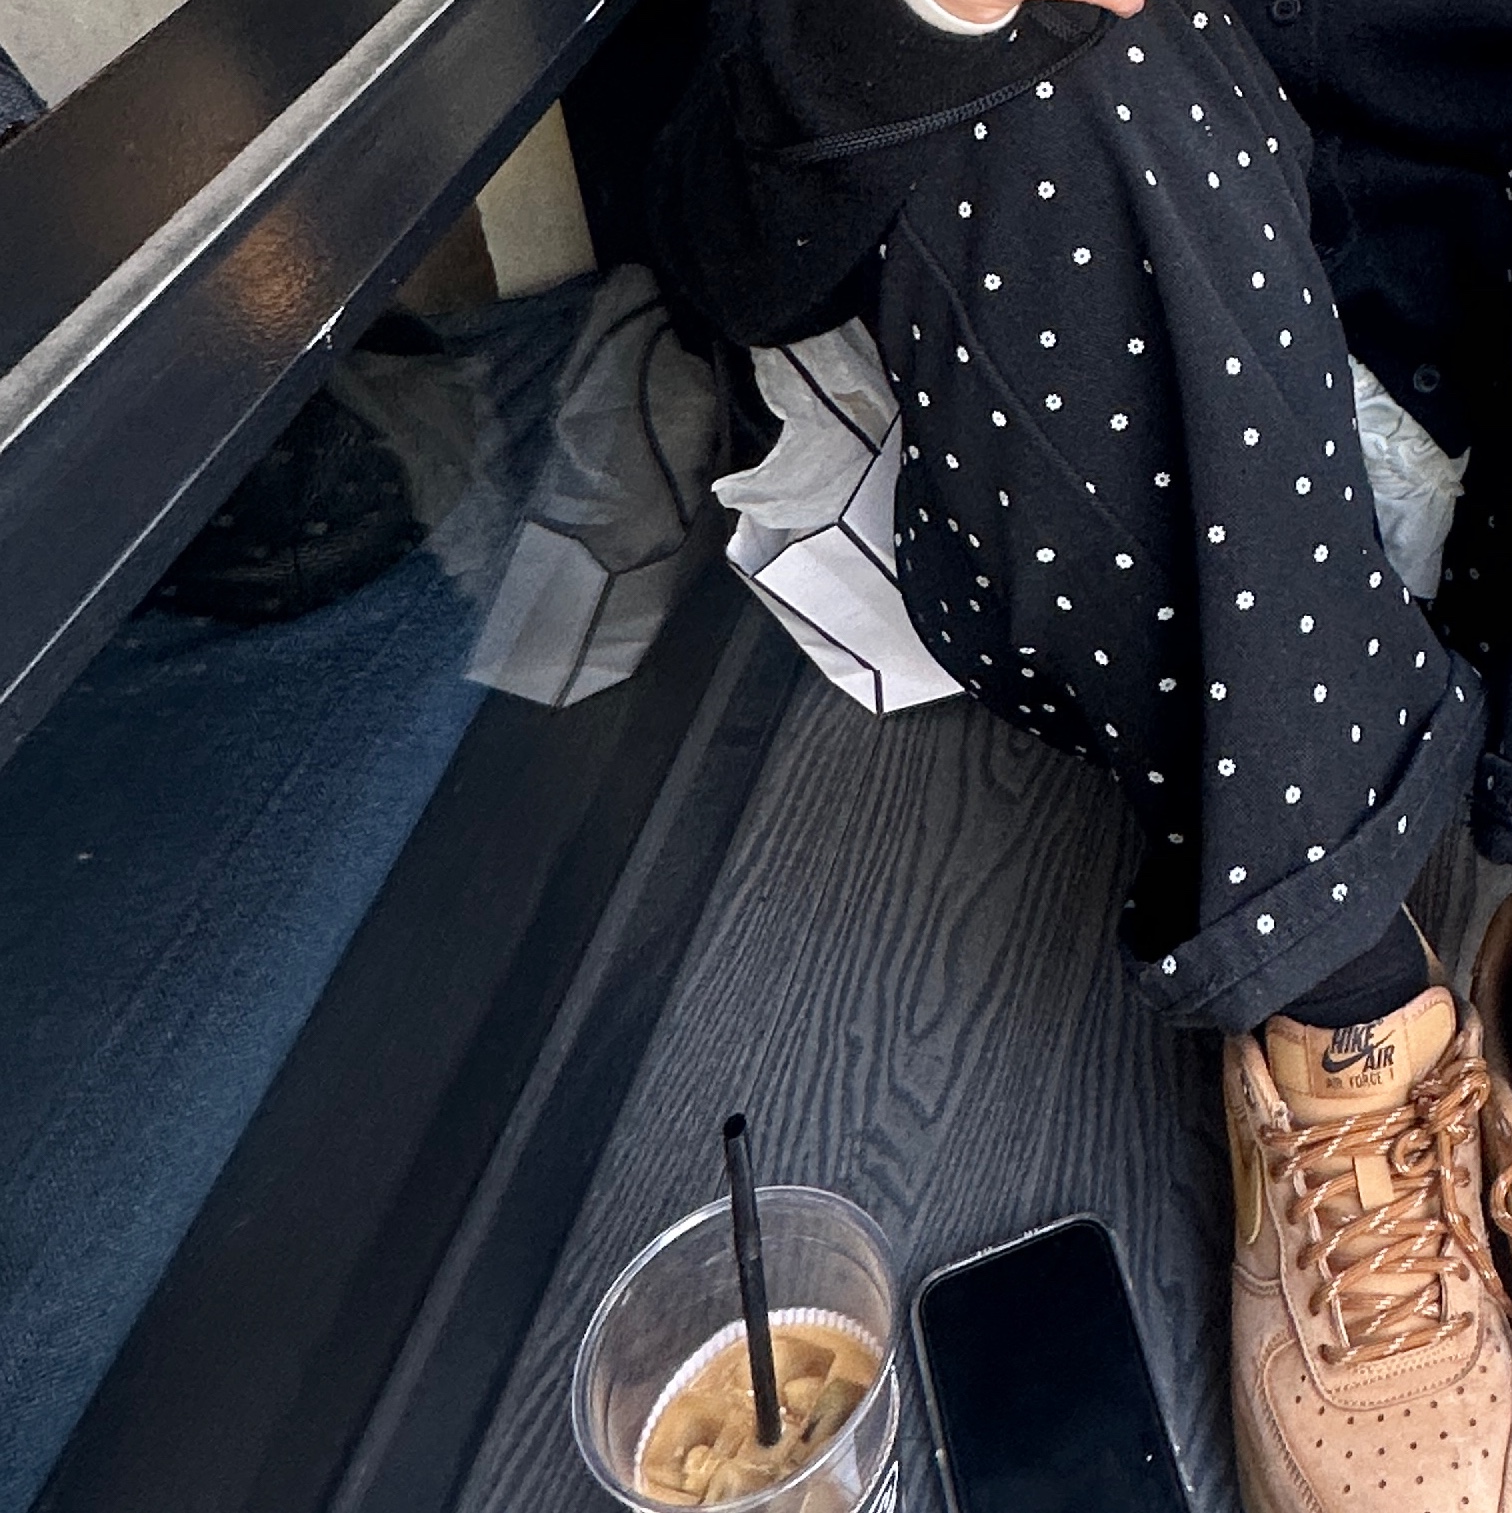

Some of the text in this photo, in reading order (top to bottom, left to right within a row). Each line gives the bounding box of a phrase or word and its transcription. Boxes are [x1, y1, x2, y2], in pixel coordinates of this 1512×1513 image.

[1330, 1023, 1375, 1054] NIKE
[1363, 1044, 1395, 1072] AIR
[1326, 1076, 1344, 1089] AIR
[1349, 1071, 1383, 1088] FORCE
